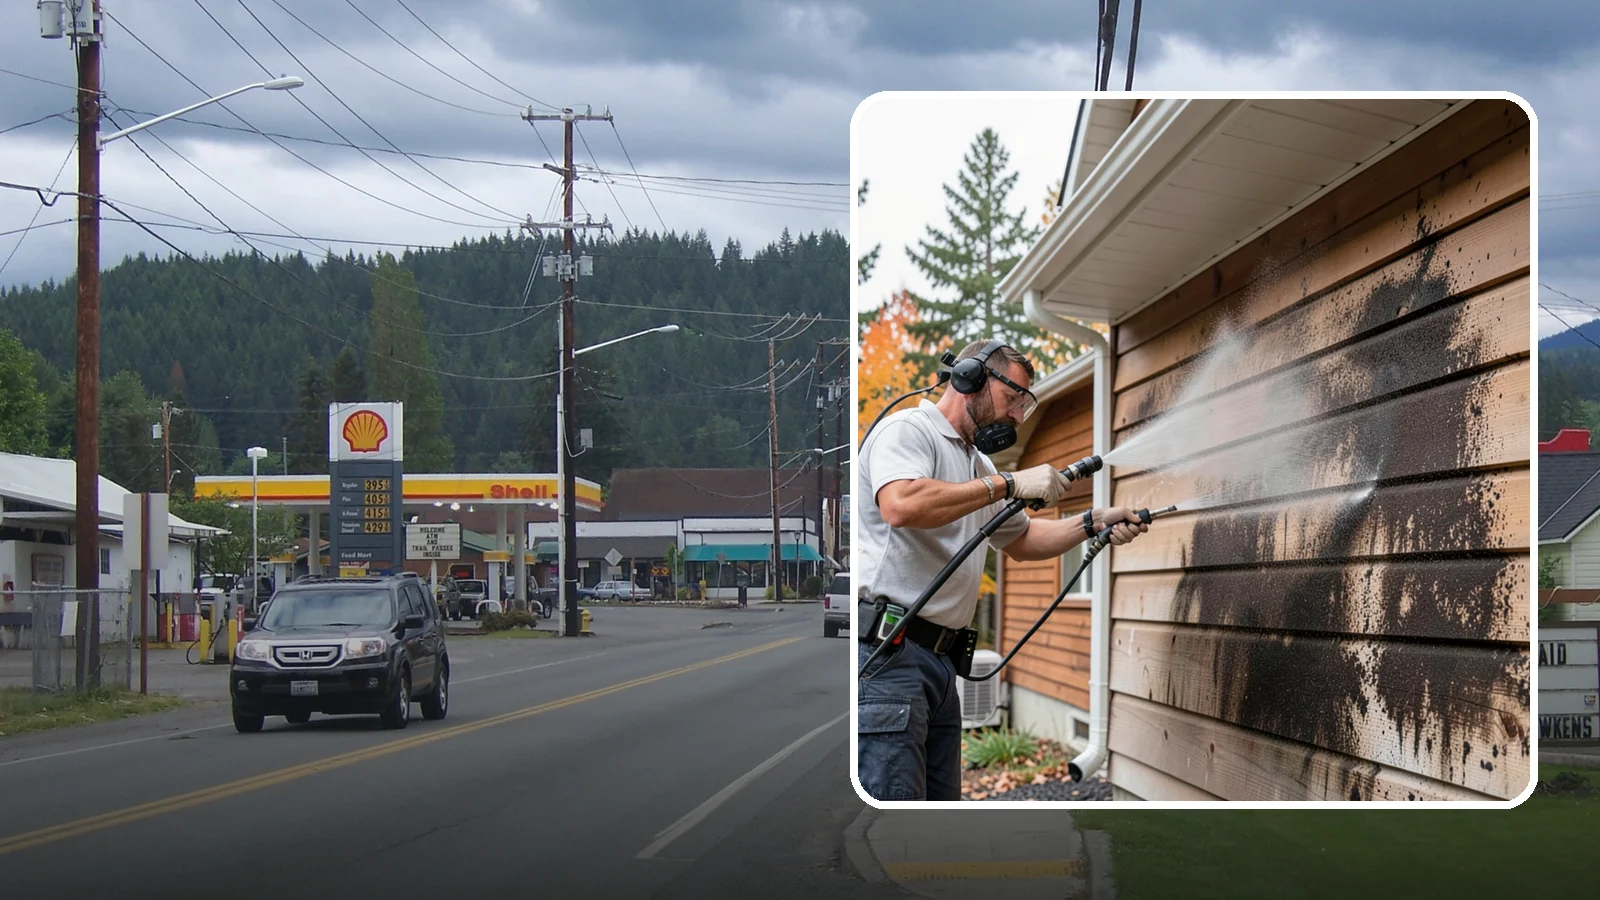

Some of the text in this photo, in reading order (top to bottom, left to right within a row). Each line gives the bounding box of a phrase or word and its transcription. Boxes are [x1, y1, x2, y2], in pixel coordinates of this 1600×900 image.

[365, 480, 384, 490] 395
[490, 484, 547, 499] Shell
[365, 494, 384, 504] 405
[365, 508, 384, 518] 415
[365, 522, 384, 532] 429
[1538, 643, 1567, 665] AID
